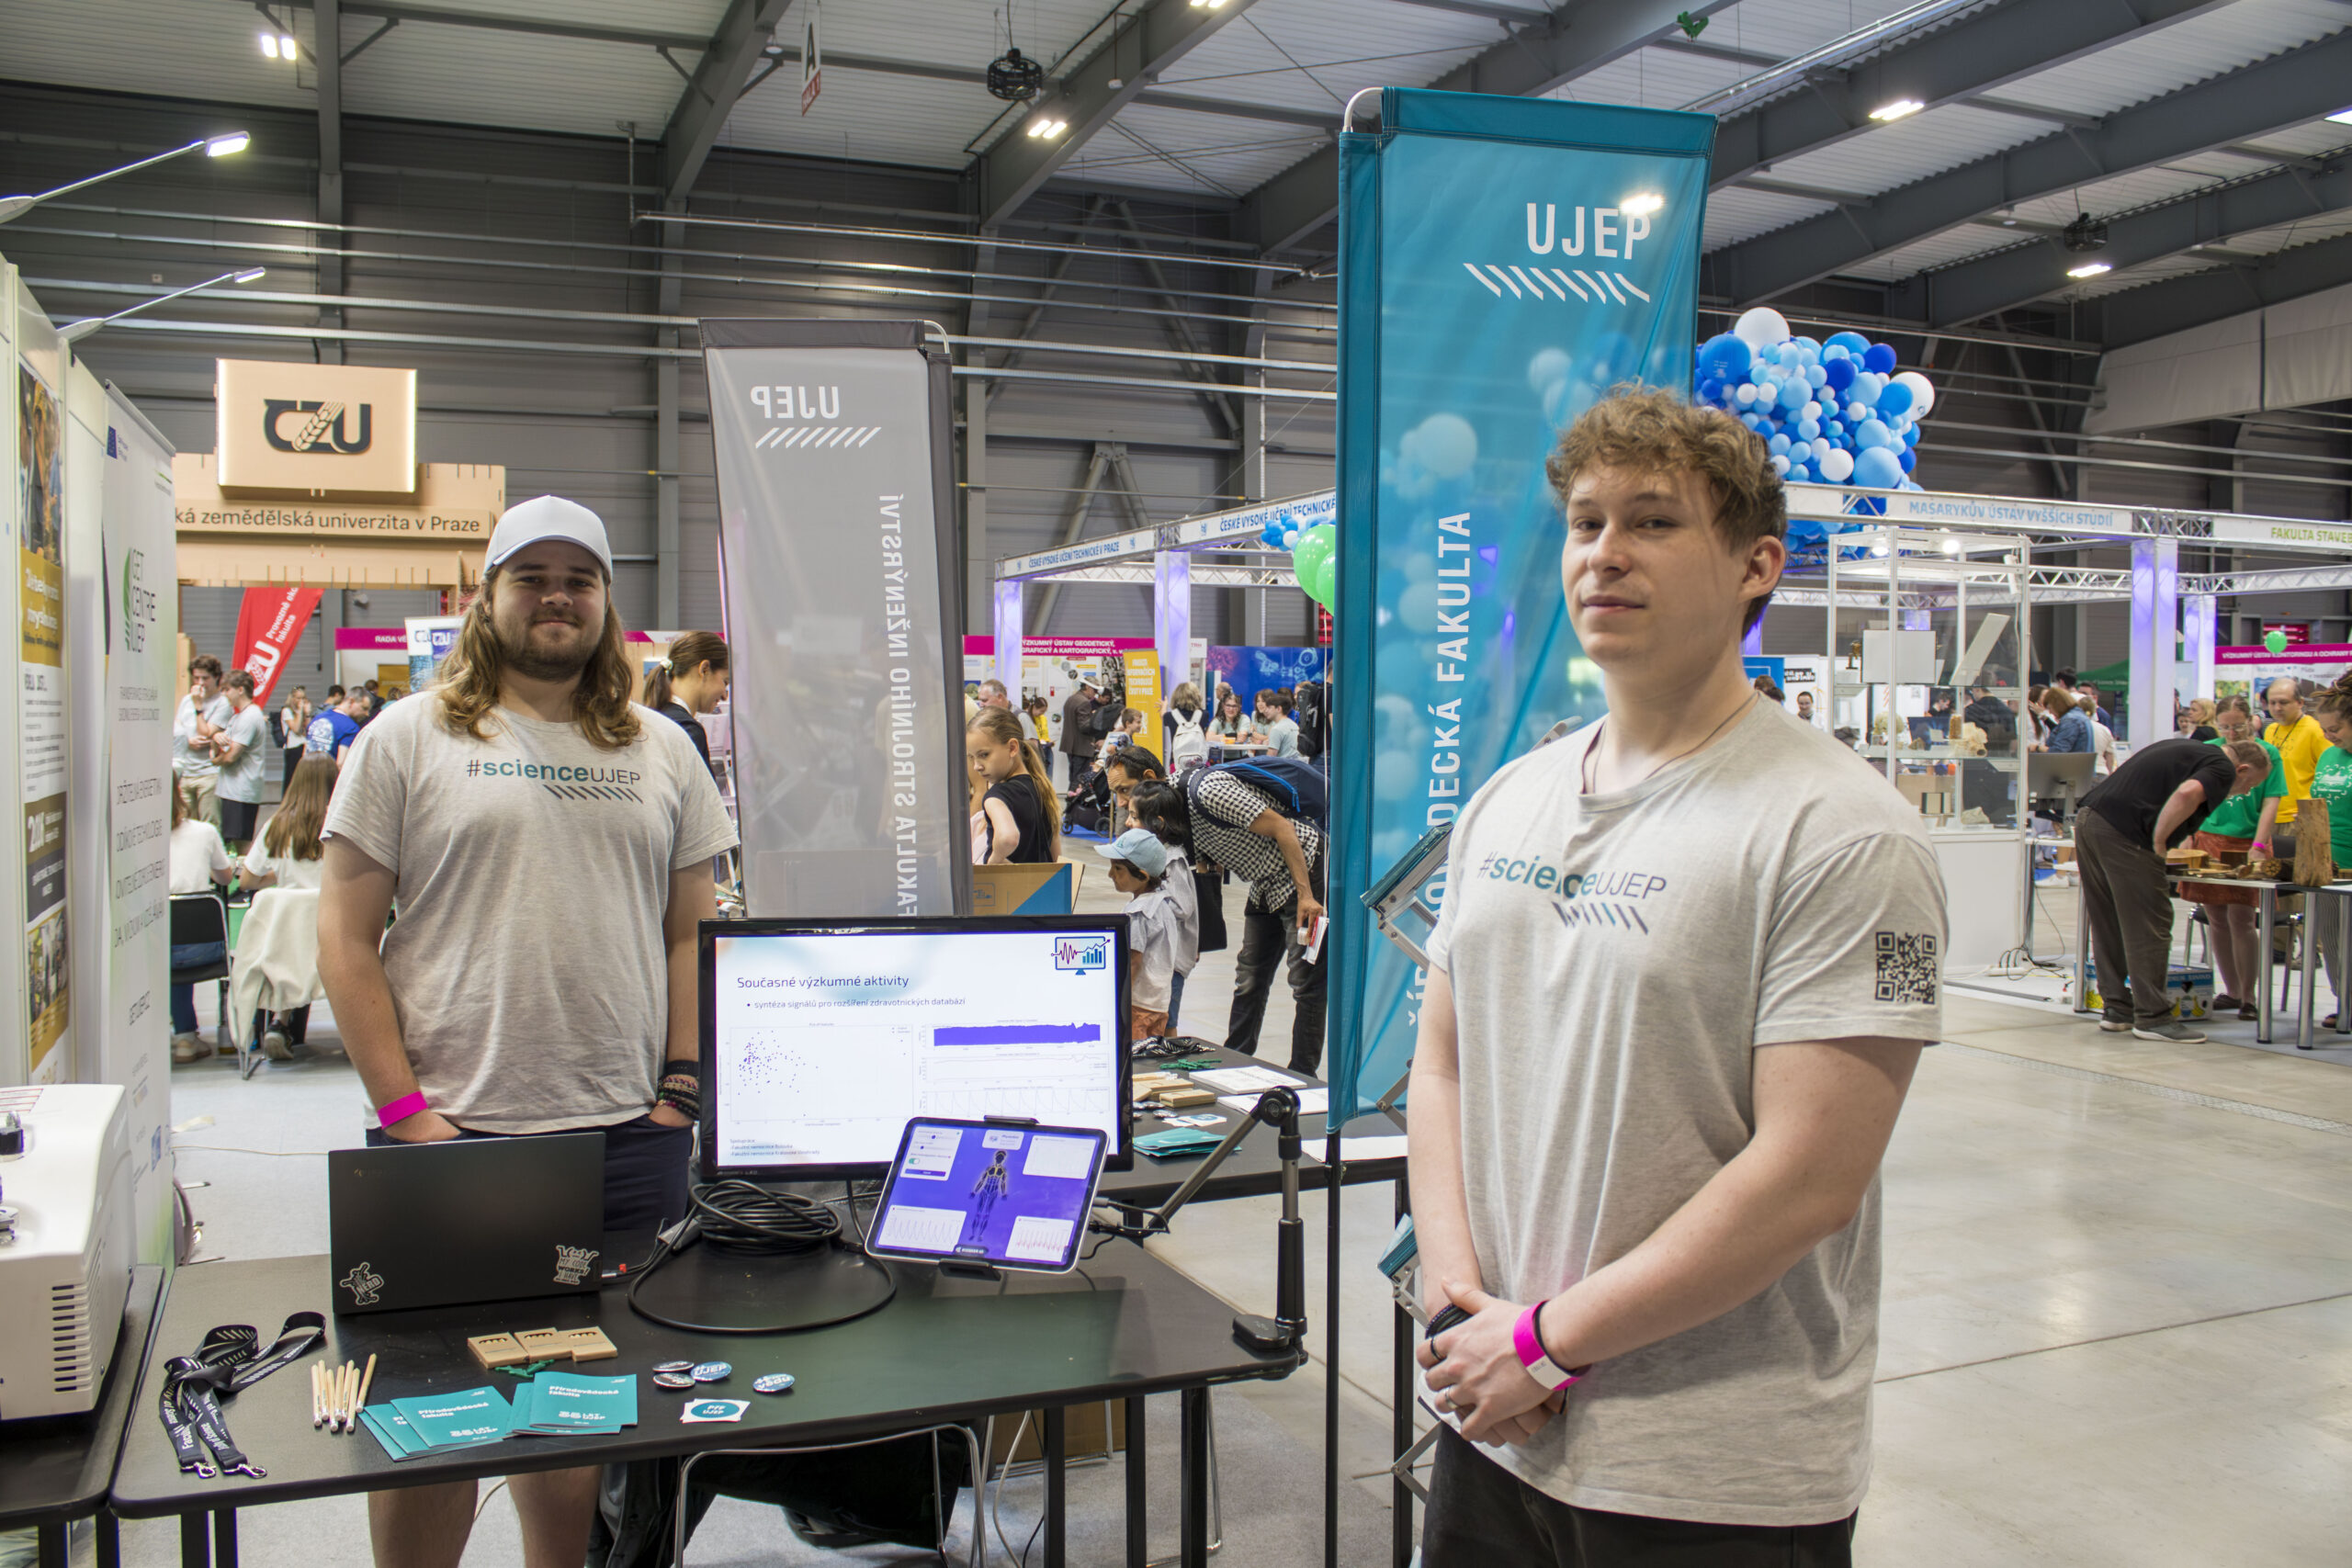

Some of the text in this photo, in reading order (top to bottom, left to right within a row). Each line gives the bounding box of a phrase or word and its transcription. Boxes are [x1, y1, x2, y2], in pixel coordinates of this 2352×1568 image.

[805, 22, 816, 81] A
[1526, 202, 1651, 260] UJEP
[201, 509, 314, 527] zemědělská
[319, 512, 410, 531] univerzita
[415, 519, 425, 530] v
[431, 516, 481, 532] Praze
[1219, 514, 1240, 532] ČESKÉ
[1241, 508, 1268, 528] VYSOKÉ
[1909, 501, 2113, 527] MASARYKŮV ÚSTAV VYŠŠÍCH STUDIÍ
[2271, 526, 2314, 540] FAKULTA
[1437, 512, 1471, 682] FAKULTA
[1022, 638, 1053, 647] ÝZKUMNÝ
[1054, 638, 1074, 647] ÚSTAV
[467, 759, 641, 785] #scienceUJEP
[737, 975, 909, 989] Současné výzkumné aktivity
[754, 997, 966, 1010] syntéza signálů pro rozšíření zdravotnických databází
